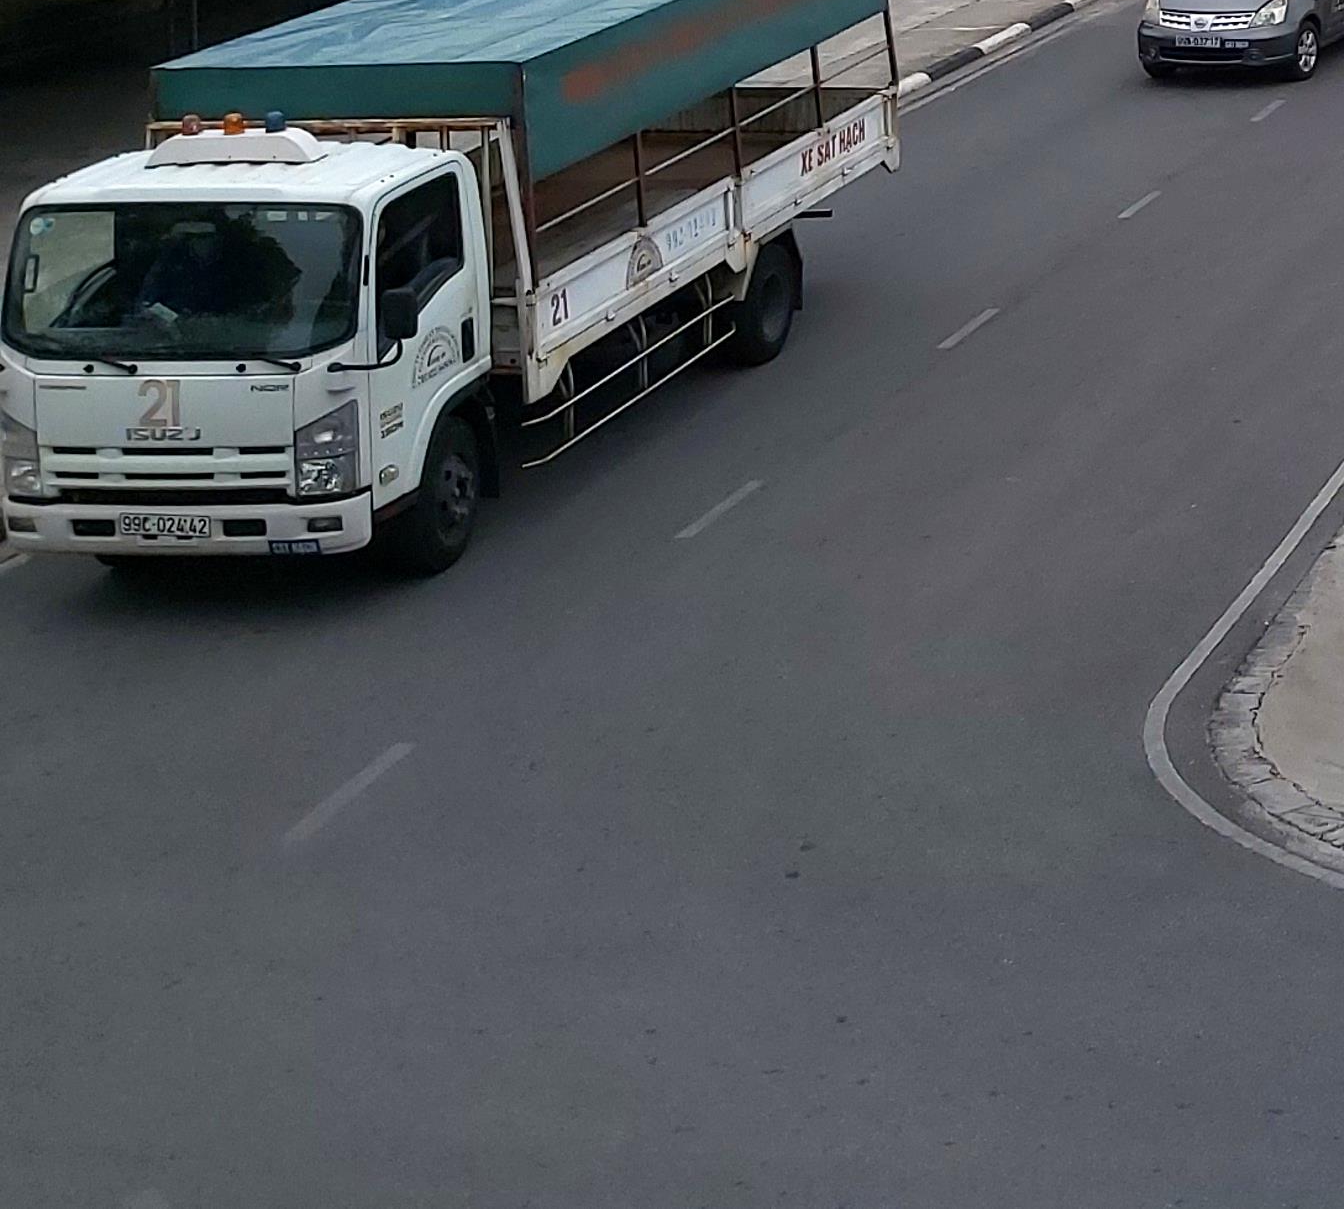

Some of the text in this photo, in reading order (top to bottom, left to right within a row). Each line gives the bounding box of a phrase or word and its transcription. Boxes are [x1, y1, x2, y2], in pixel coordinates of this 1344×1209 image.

[801, 148, 814, 177] XE
[551, 290, 569, 327] 21
[137, 379, 181, 428] 21
